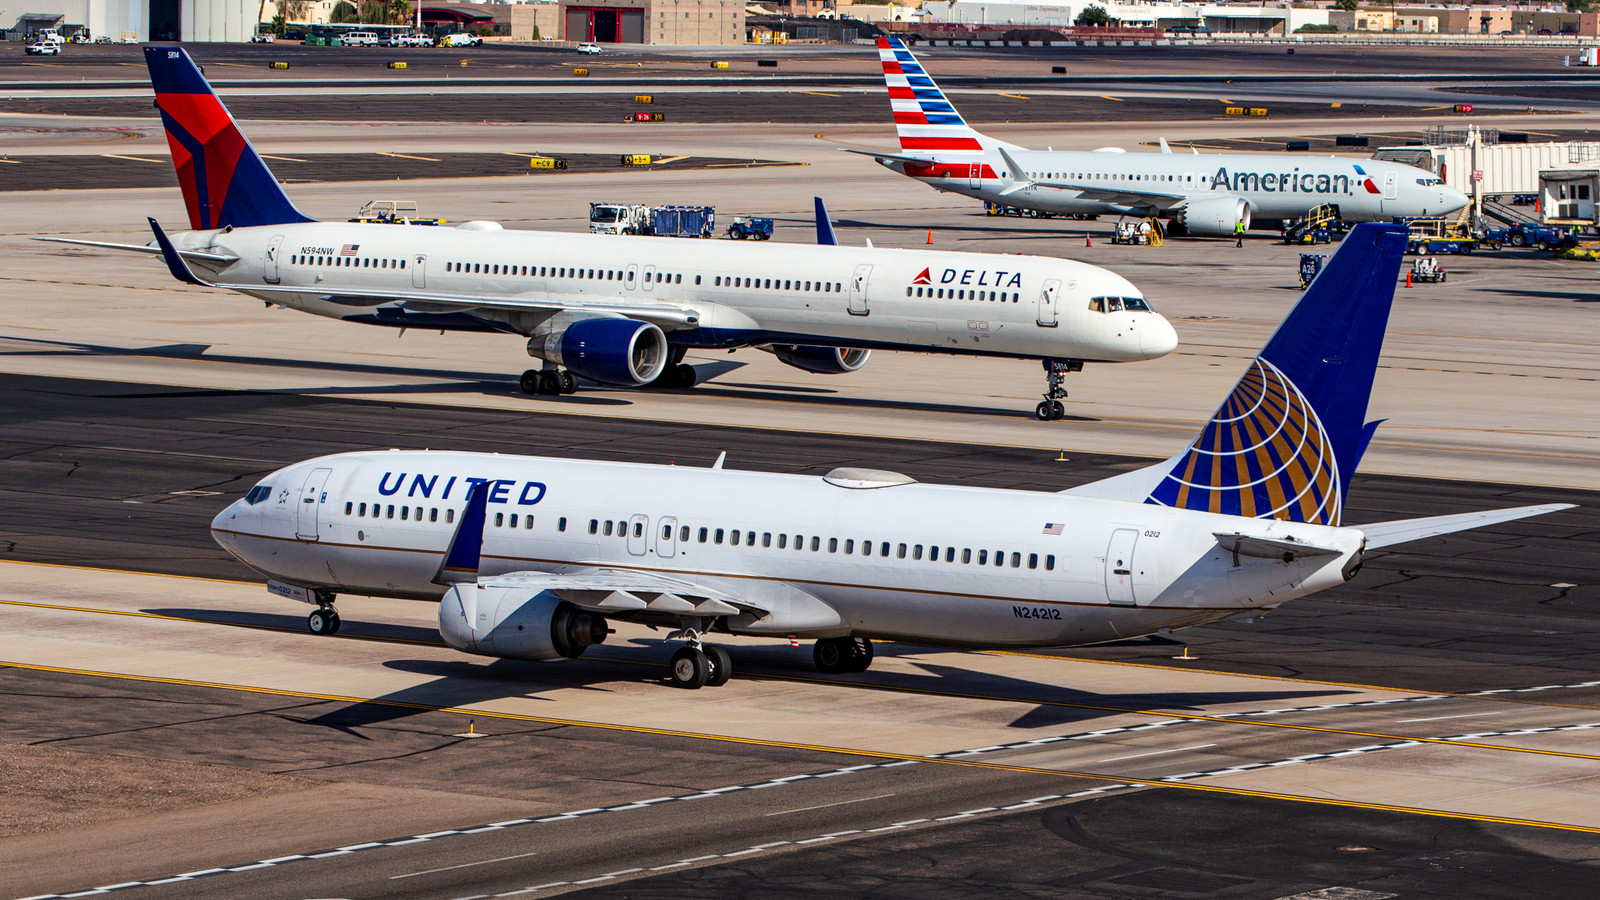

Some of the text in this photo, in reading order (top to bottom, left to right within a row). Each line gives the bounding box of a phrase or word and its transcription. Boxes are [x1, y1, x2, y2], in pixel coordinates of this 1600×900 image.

[1210, 167, 1349, 193] American
[300, 246, 336, 256] N594NW
[1302, 264, 1315, 274] A26
[940, 268, 1022, 289] DELTA
[378, 472, 547, 506] UNITED
[1144, 530, 1161, 538] 0212
[1012, 606, 1063, 620] N24212
